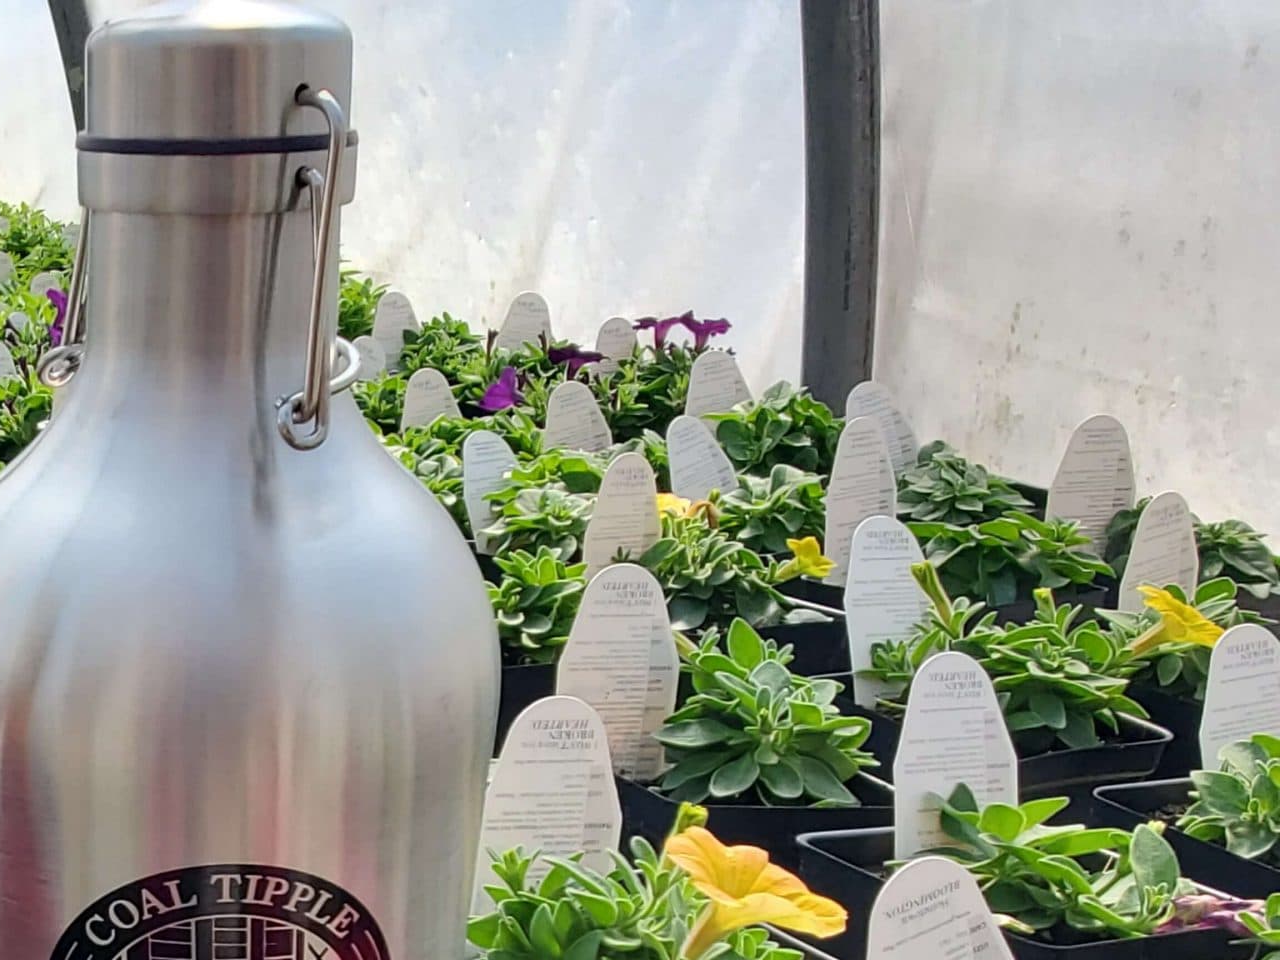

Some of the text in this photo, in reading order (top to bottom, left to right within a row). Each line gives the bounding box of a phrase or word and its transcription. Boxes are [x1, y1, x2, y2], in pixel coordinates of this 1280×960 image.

[548, 729, 593, 739] BROKEN
[86, 873, 361, 946] COAL TIPPLE
